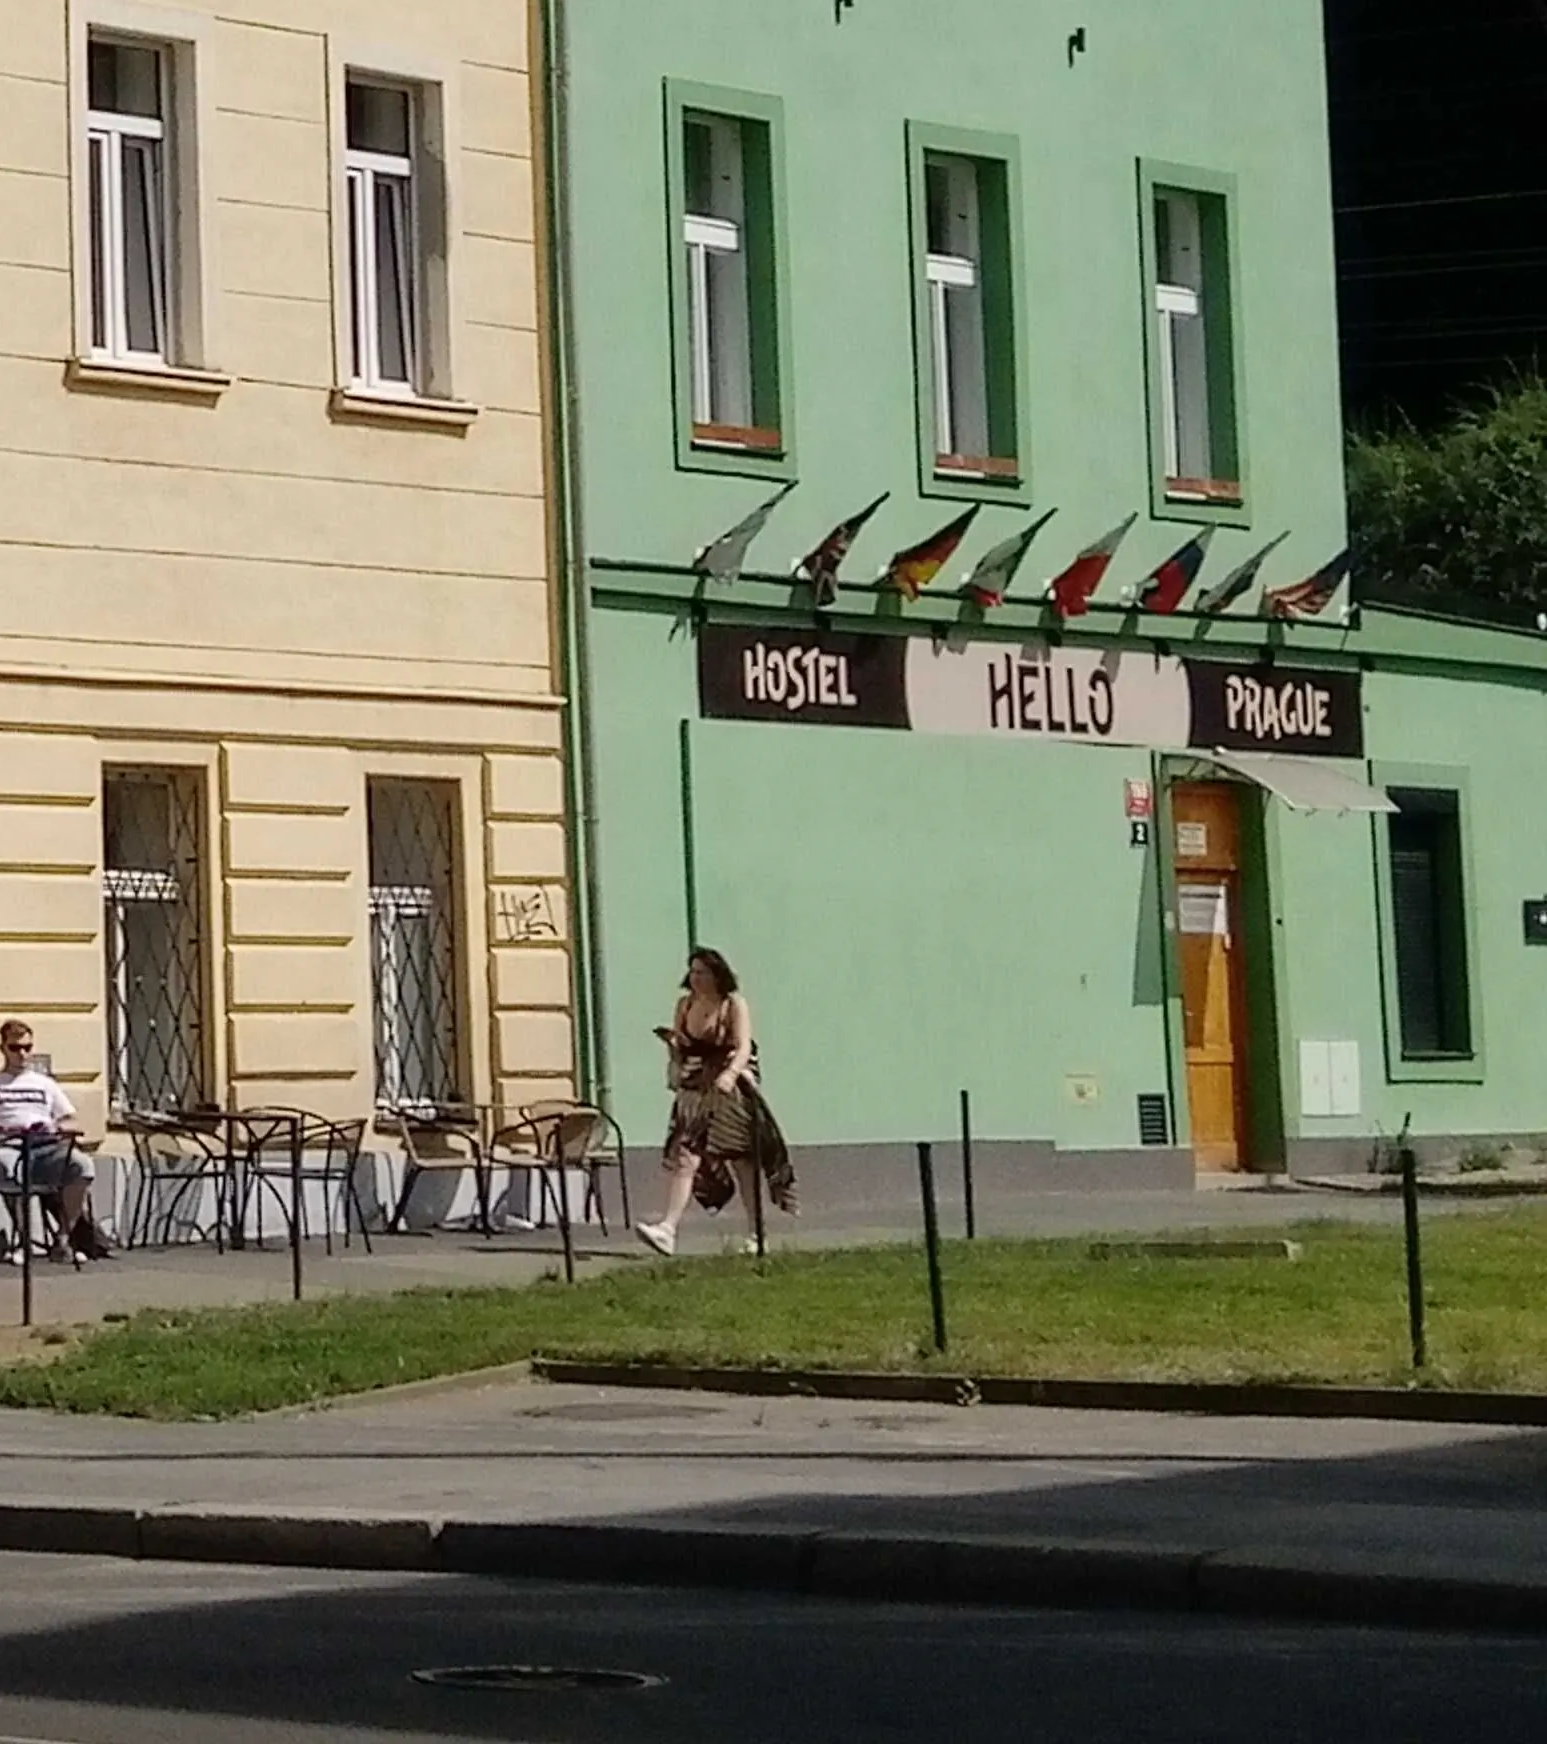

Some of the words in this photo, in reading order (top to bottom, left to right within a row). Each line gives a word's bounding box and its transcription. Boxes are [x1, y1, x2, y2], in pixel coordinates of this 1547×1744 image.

[742, 642, 858, 711] HOSTEL
[987, 652, 1116, 736] HELLO
[1225, 674, 1332, 740] PRAGUE
